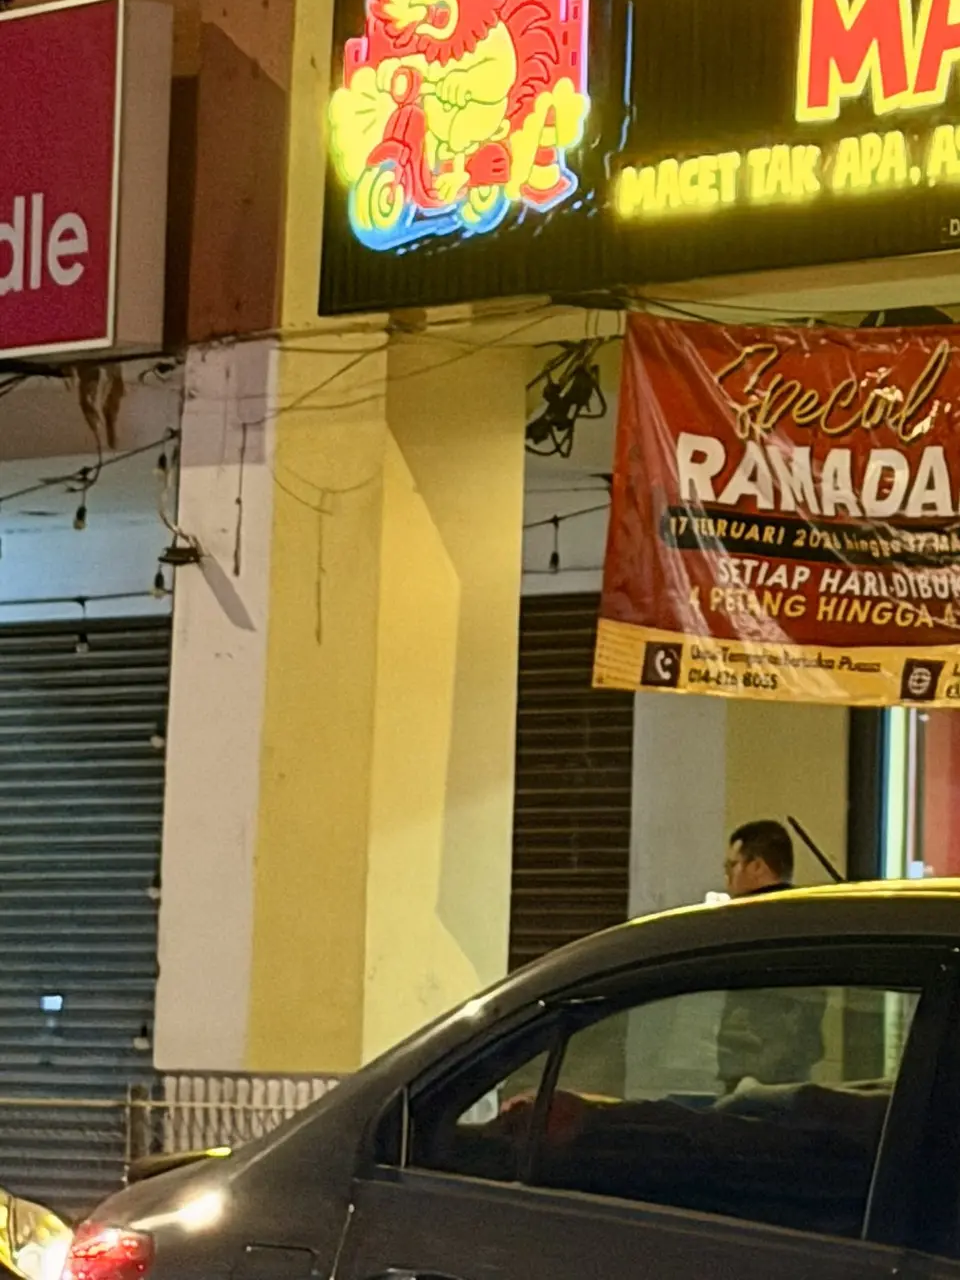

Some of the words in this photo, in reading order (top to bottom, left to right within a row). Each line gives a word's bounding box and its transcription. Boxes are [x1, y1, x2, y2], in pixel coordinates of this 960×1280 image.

[619, 152, 741, 214] MACET
[748, 144, 821, 197] TAK
[718, 558, 812, 590] SETIAP
[819, 568, 889, 597] HARI
[710, 586, 808, 618] PETANG
[816, 596, 934, 628] HINGGA
